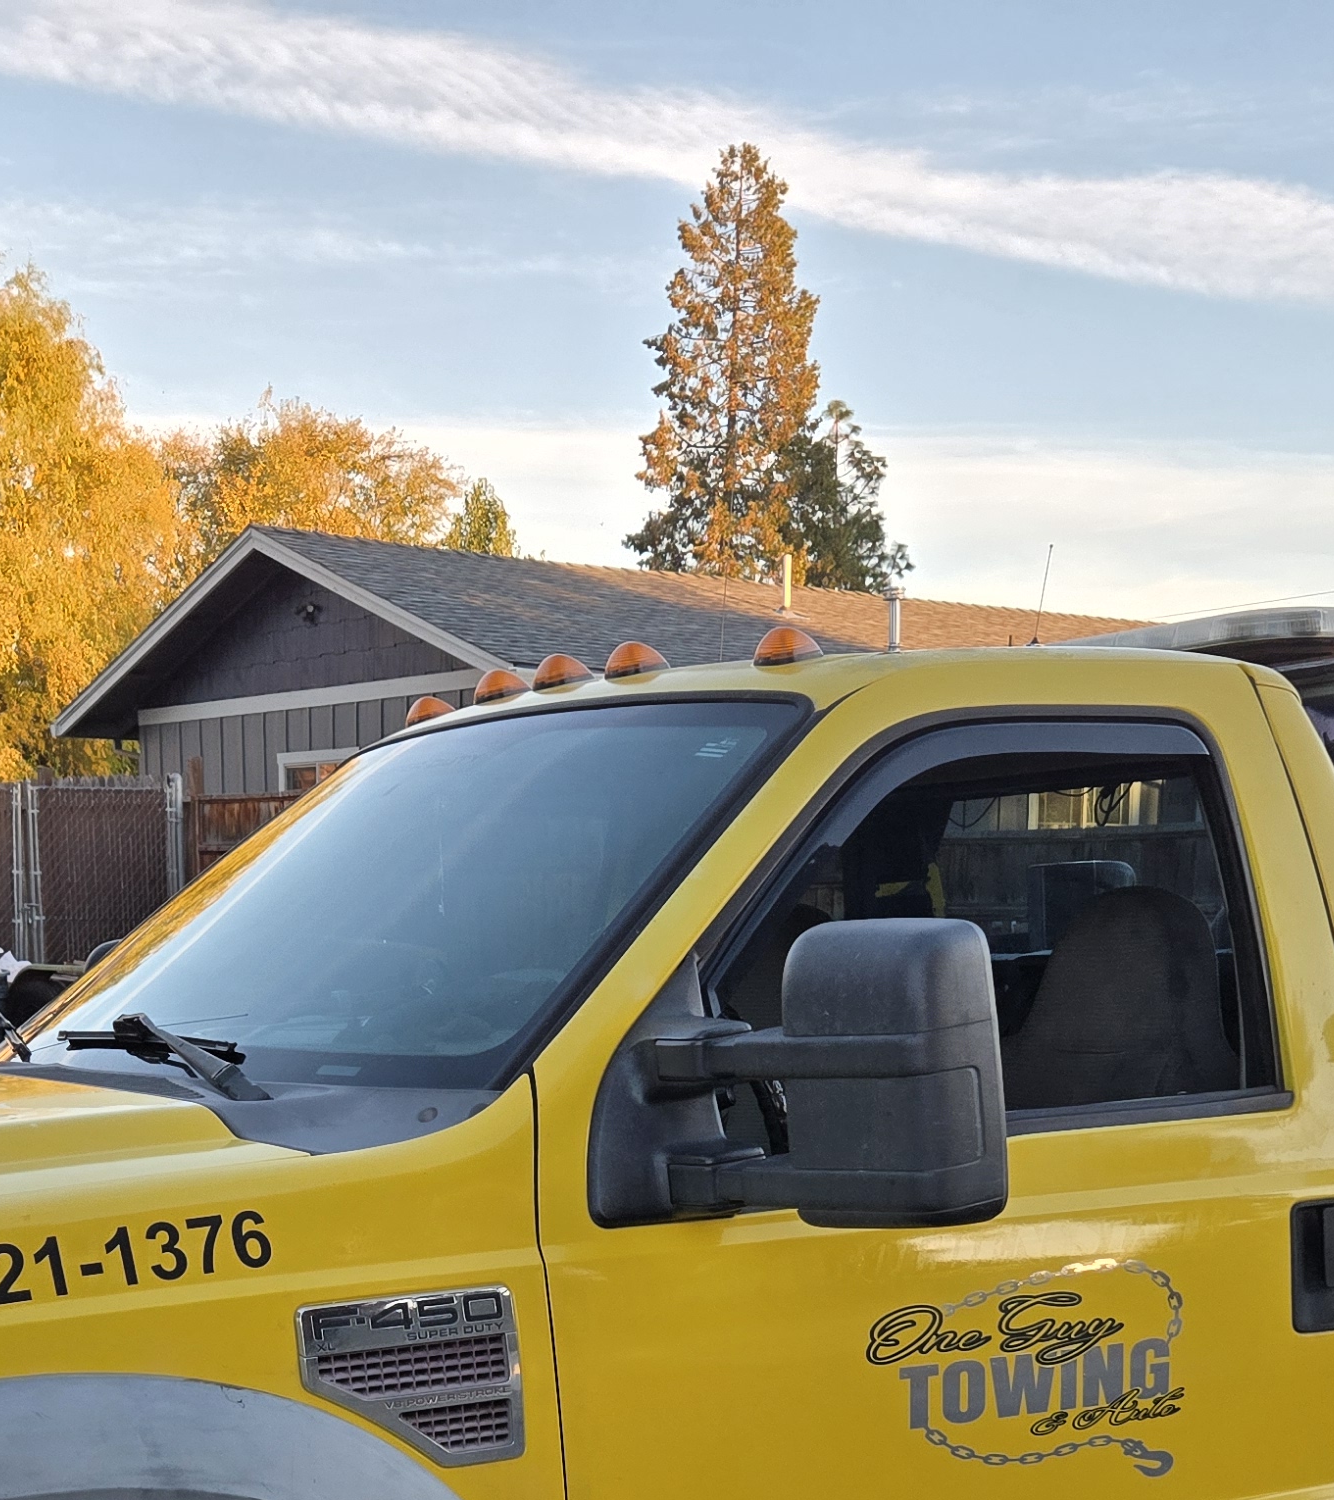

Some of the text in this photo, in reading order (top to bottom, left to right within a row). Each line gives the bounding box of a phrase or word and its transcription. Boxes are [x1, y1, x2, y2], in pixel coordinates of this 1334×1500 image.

[311, 1290, 504, 1341] F-450
[406, 1321, 504, 1342] SUPER DUTY
[866, 1291, 1124, 1366] One Guy
[316, 1343, 336, 1353] XL
[384, 1400, 405, 1410] V8
[899, 1338, 1171, 1430] TOWING
[1030, 1387, 1185, 1436] & Auto
